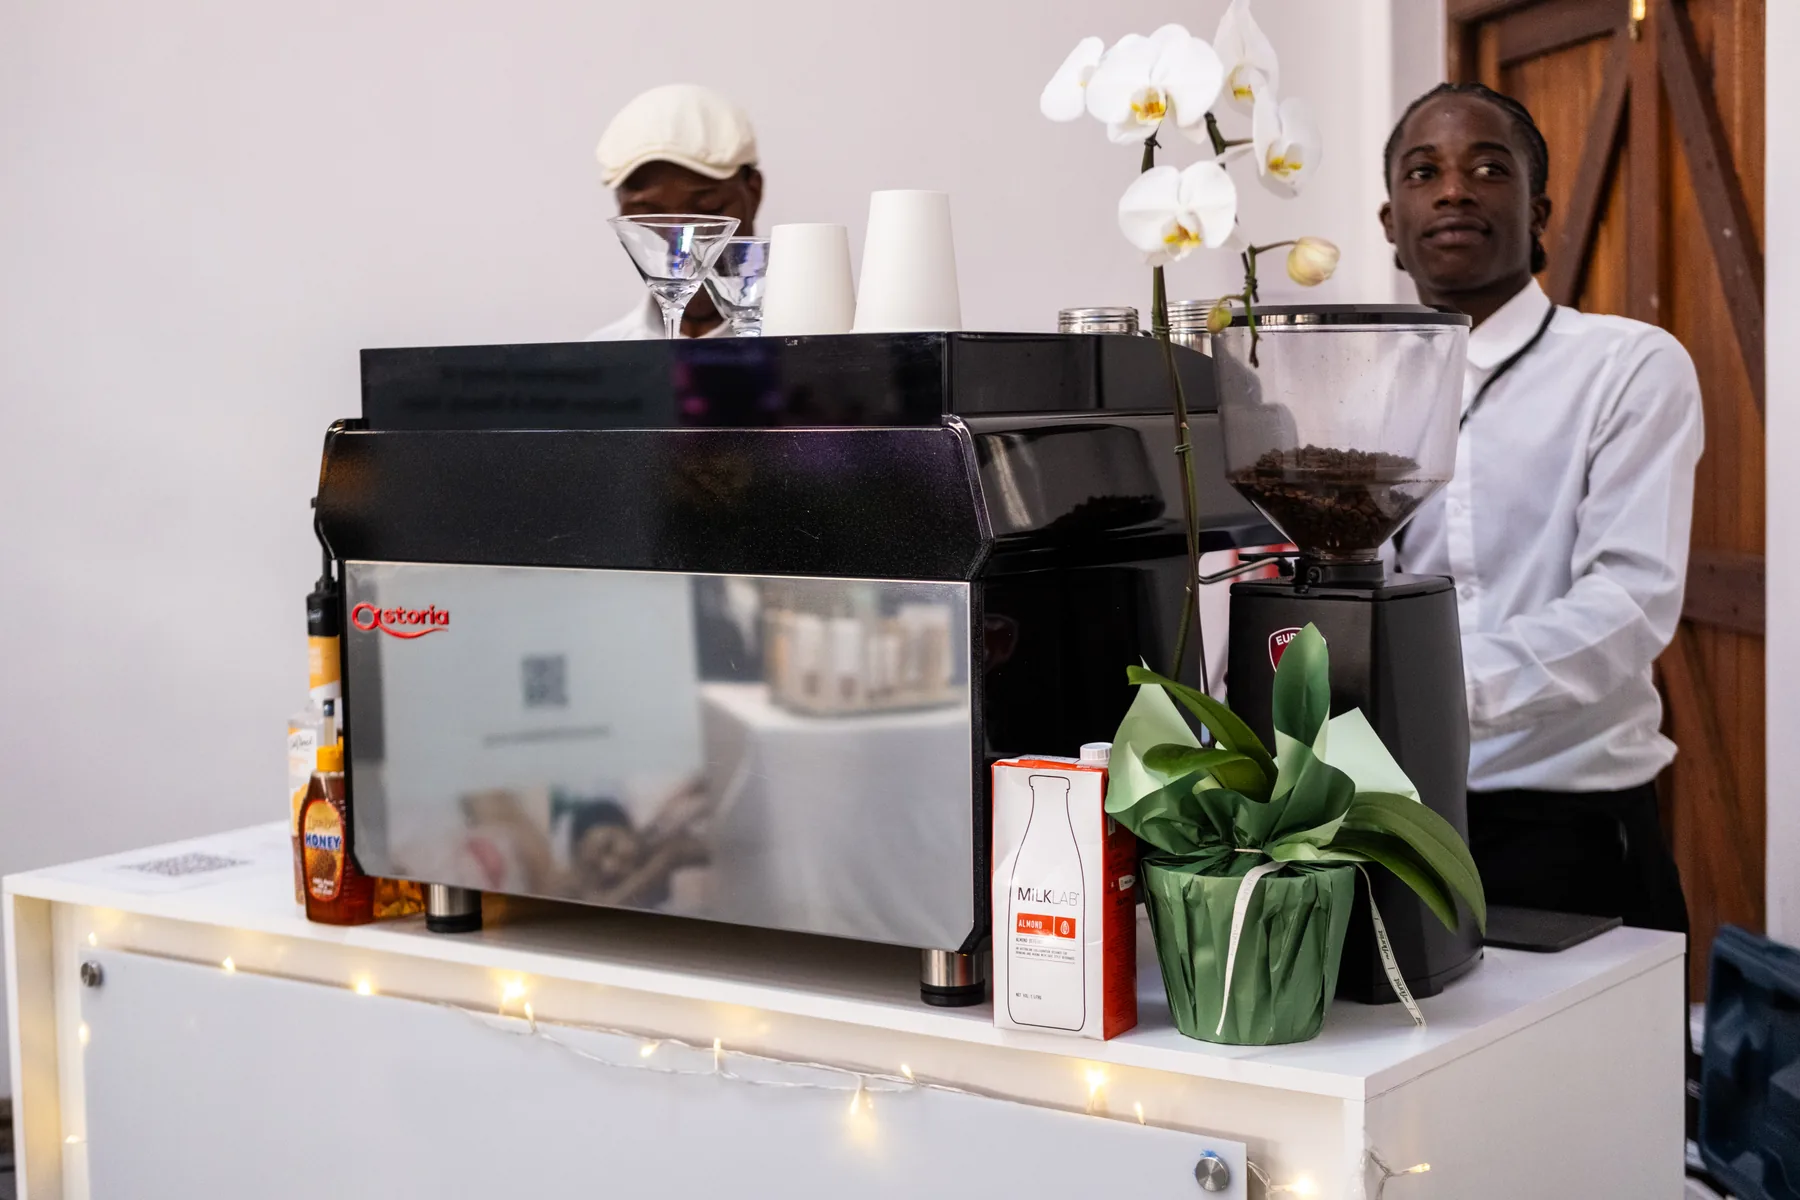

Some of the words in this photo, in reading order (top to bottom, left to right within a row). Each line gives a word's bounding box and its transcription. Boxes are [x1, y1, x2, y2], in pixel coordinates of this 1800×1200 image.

[352, 602, 449, 639] astoria
[305, 833, 341, 851] HONEY
[1018, 919, 1043, 930] ALMOND
